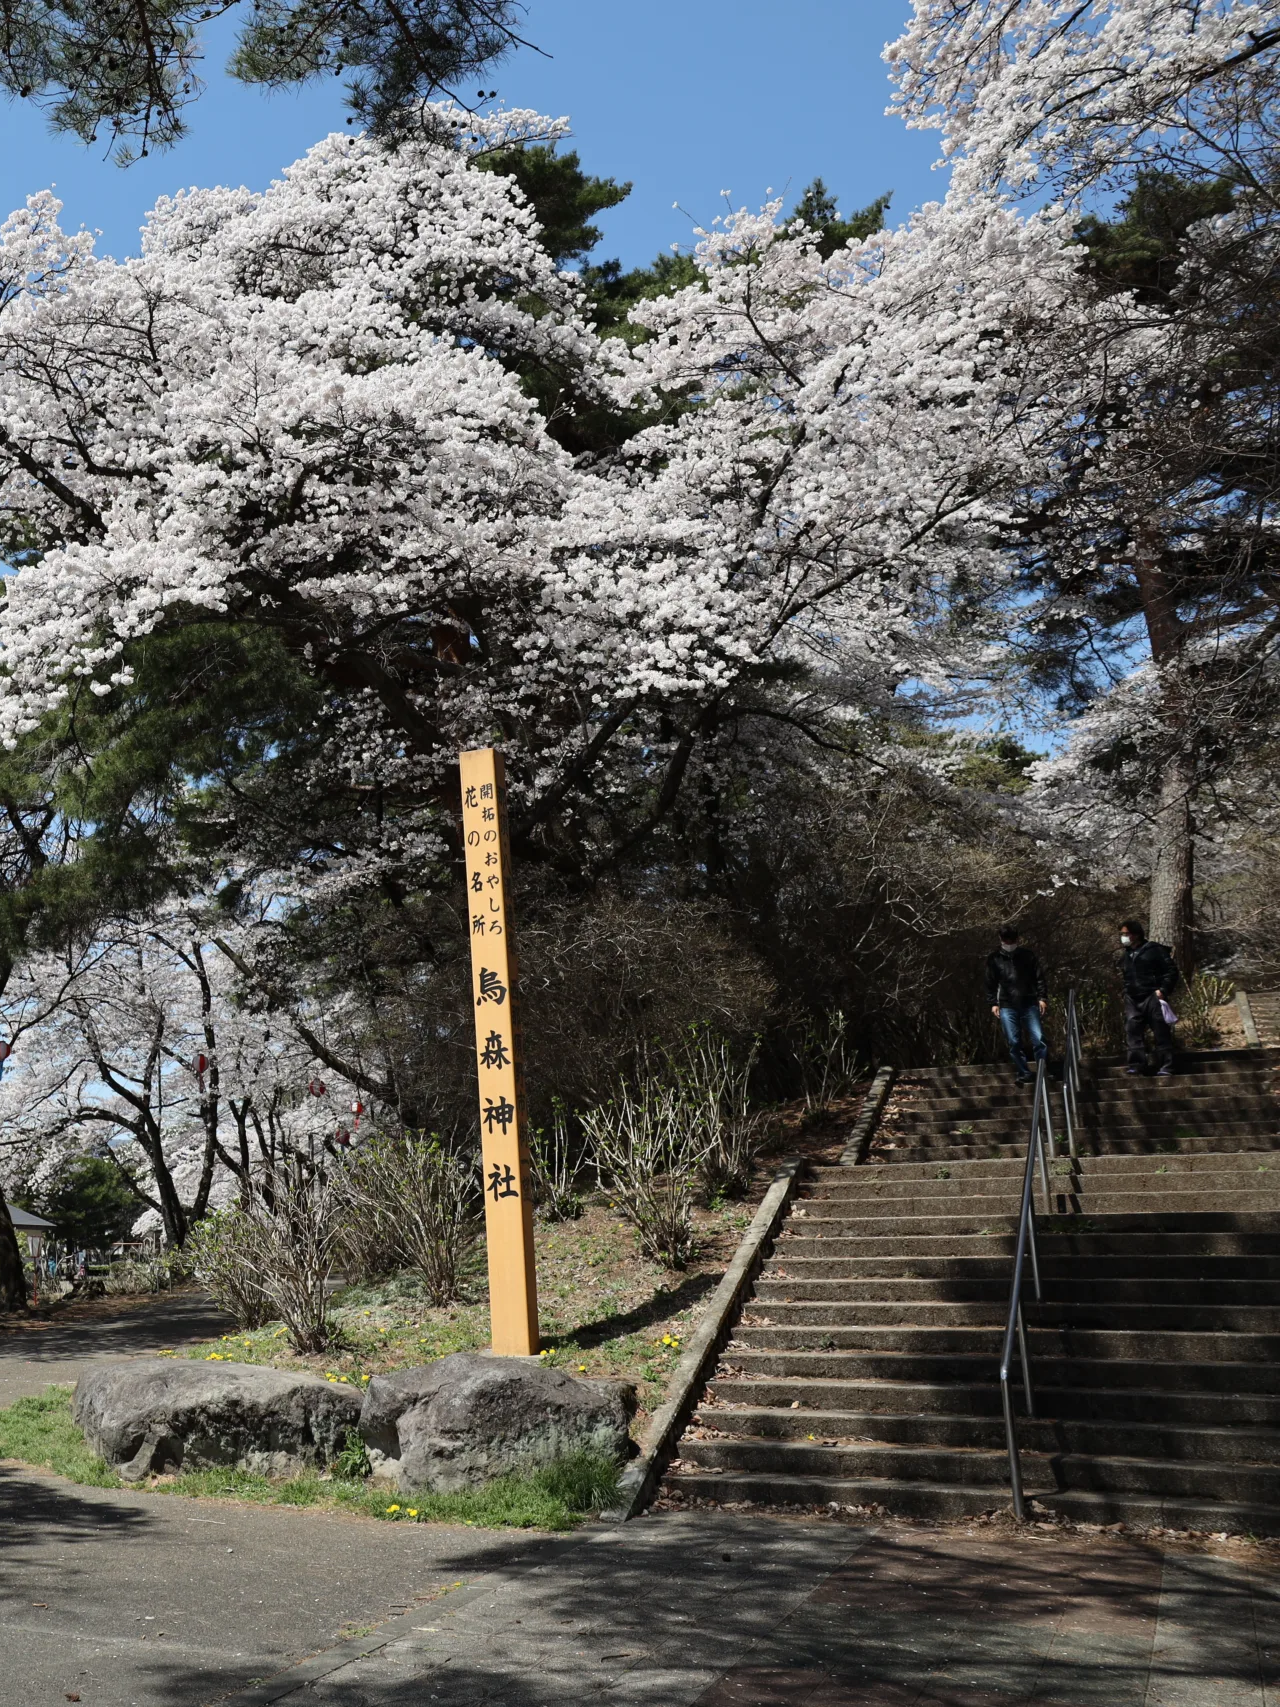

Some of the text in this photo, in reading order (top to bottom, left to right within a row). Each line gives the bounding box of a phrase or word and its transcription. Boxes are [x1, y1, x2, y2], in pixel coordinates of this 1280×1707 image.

[464, 786, 485, 936] 花の名所
[480, 783, 503, 936] 開拓のおやしろ
[476, 967, 519, 1202] 烏森神社
